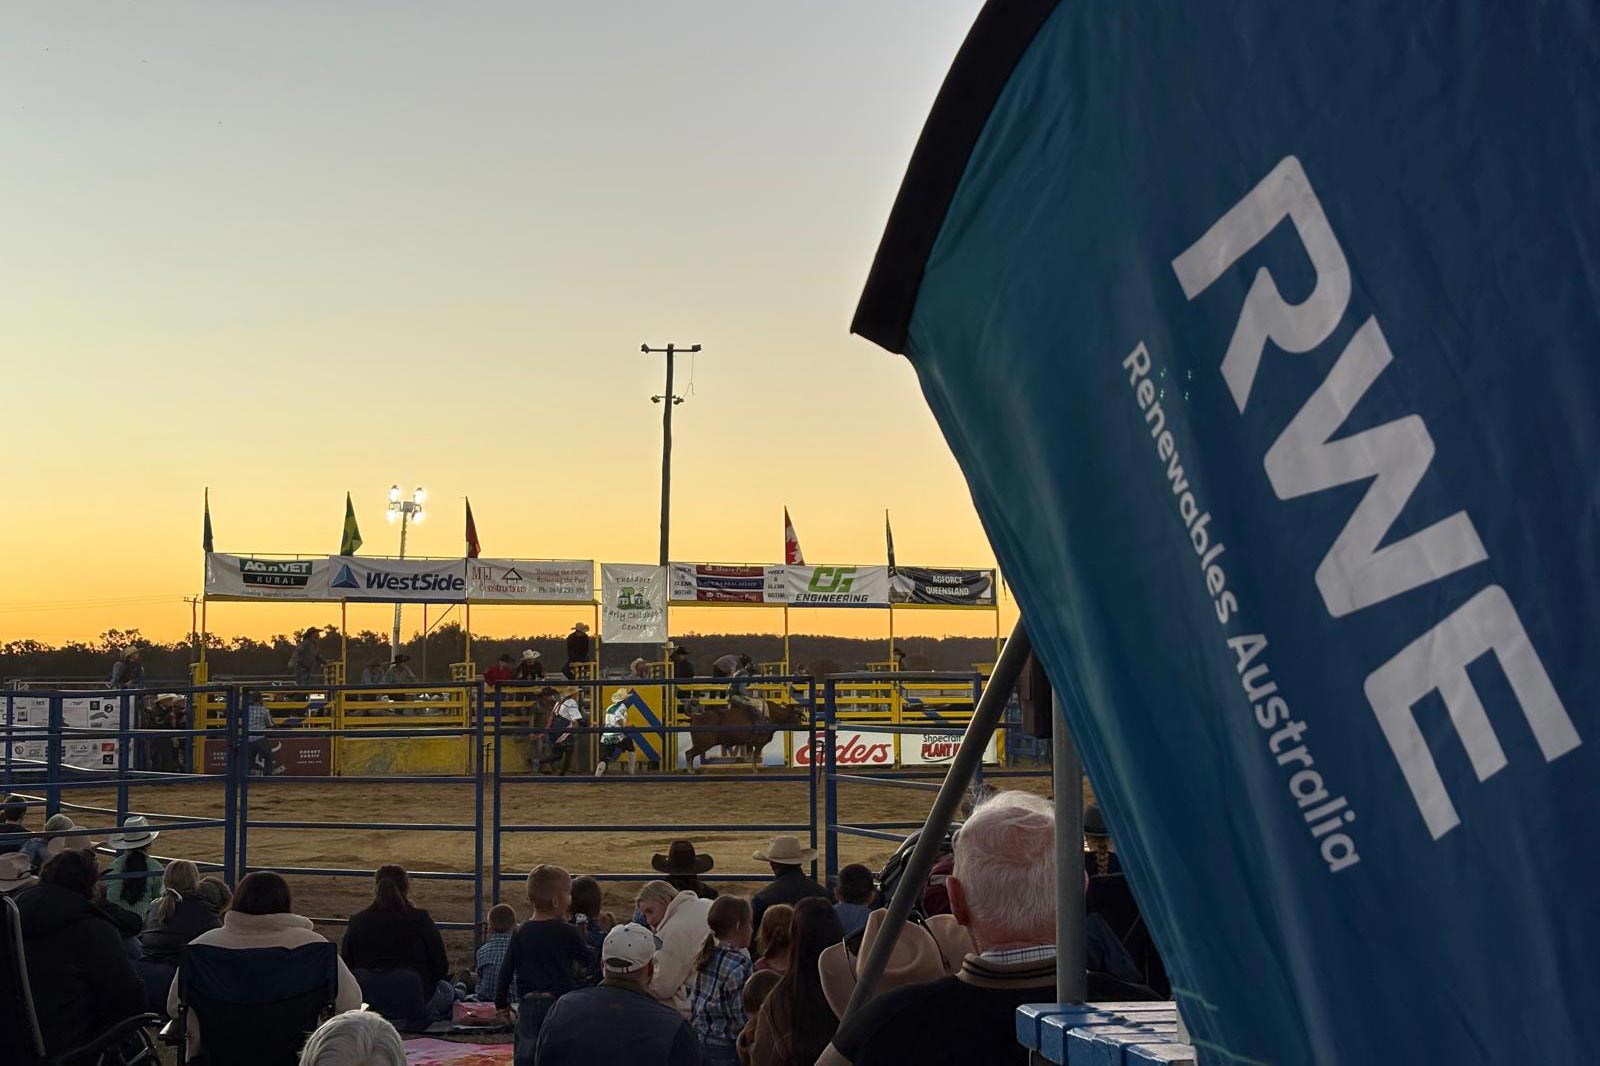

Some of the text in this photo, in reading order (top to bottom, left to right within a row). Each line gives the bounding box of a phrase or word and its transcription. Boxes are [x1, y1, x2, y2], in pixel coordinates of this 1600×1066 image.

[1171, 154, 1583, 841] RWE
[256, 576, 295, 585] RURAL
[366, 572, 465, 591] WestSide
[616, 576, 652, 584] Theodore
[926, 586, 970, 597] QUEENSLAND
[795, 593, 869, 603] ENGINEERING
[1123, 341, 1360, 873] Renewables Australia
[621, 623, 647, 631] Centre
[922, 743, 953, 757] PLANT
